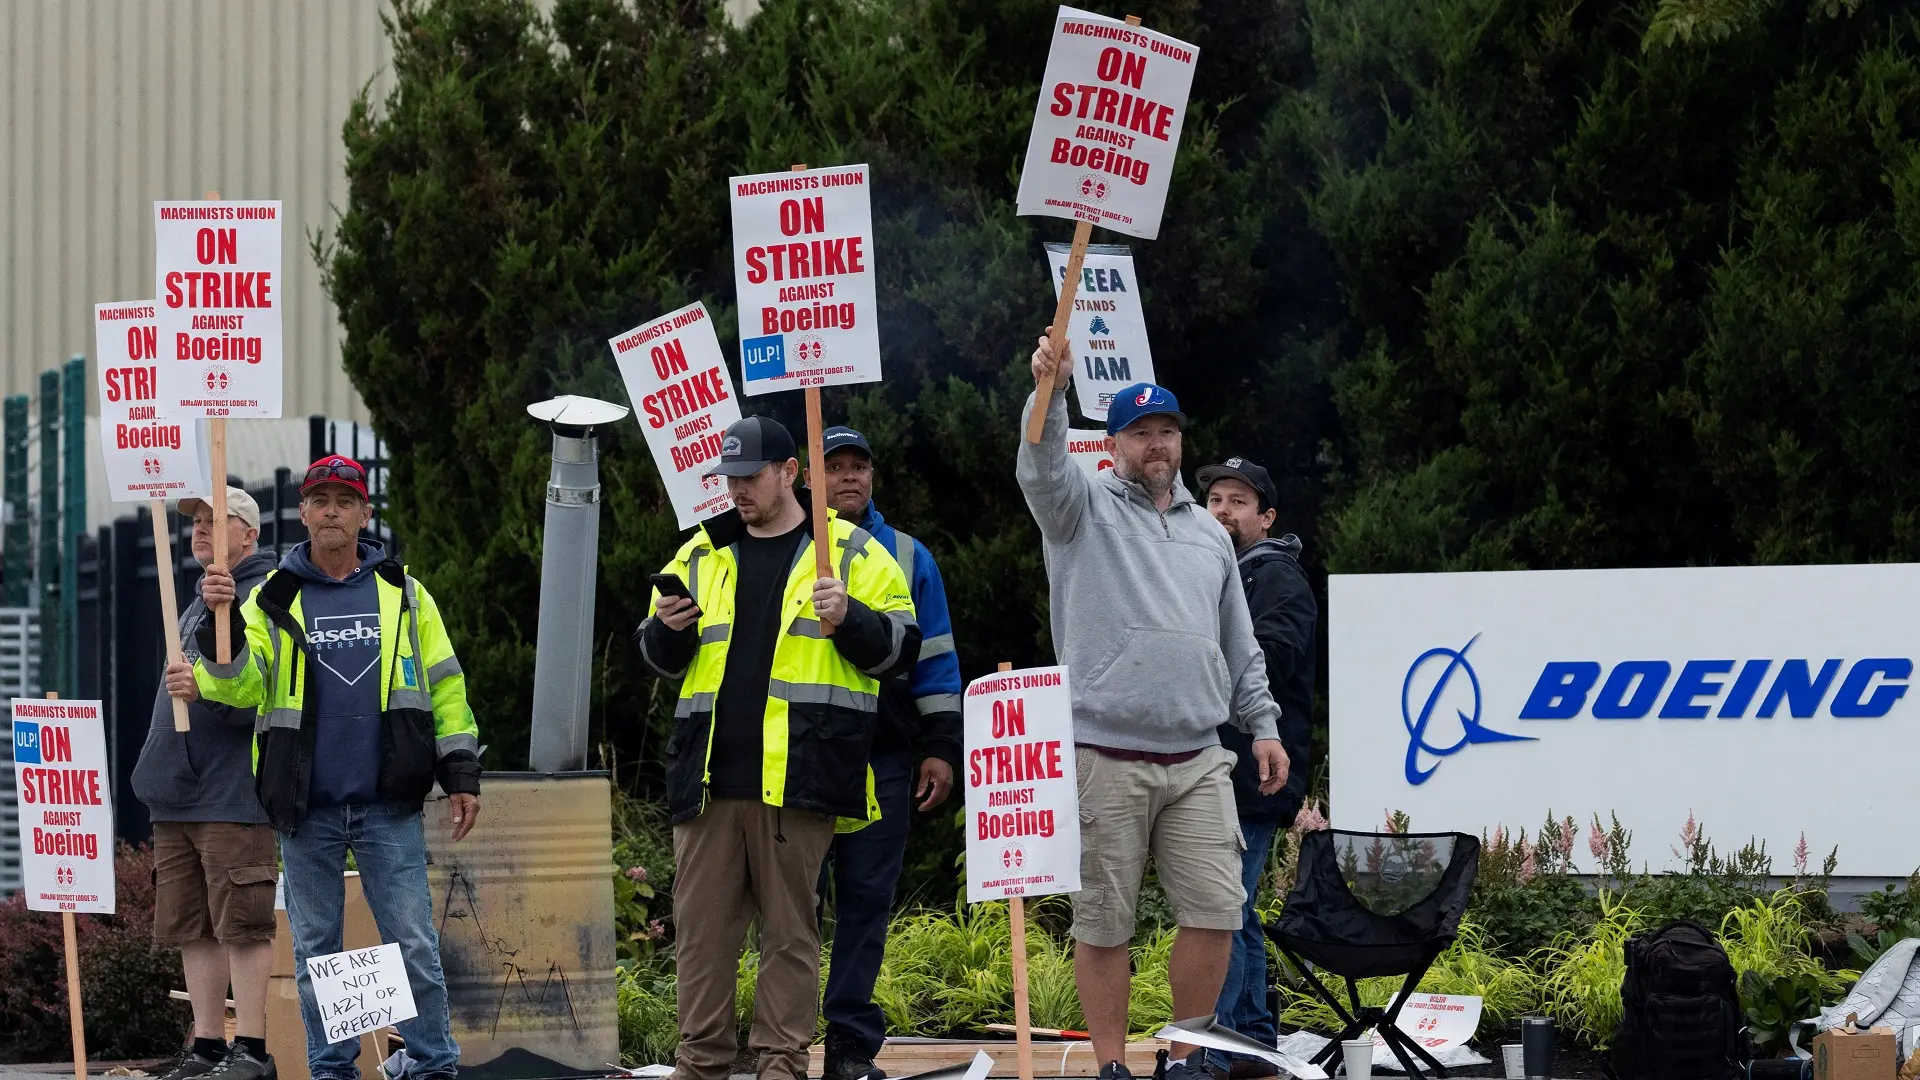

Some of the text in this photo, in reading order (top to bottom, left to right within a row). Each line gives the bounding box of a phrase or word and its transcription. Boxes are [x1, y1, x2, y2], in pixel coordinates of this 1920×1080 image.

[1063, 22, 1192, 64] MACHINISTS UNION
[1097, 47, 1147, 90] ON
[1050, 82, 1174, 142] STRIKE
[1075, 125, 1135, 150] AGAINST
[1050, 137, 1150, 186] Boeing
[737, 172, 863, 197] MACHINISTS UNION
[160, 207, 276, 220] MACHINISTS UNION
[779, 196, 825, 237] ON
[1045, 199, 1133, 224] IAM&AW DISTRICT LODGE 751
[1074, 211, 1100, 223] AFL-CIO
[196, 228, 237, 265] ON
[745, 237, 865, 284] STRIKE
[165, 271, 272, 309] STRIKE
[779, 283, 835, 302] AGAINST
[1060, 266, 1127, 293] EEA
[100, 306, 155, 321] MACHINISTS
[762, 302, 855, 335] Boeing
[1074, 299, 1116, 312] STANDS
[192, 315, 243, 330] AGAINST
[616, 307, 705, 354] MACHINISTS UNION
[127, 326, 157, 361] ON
[176, 332, 262, 364] Boeing
[747, 345, 780, 365] ULP!
[1089, 339, 1115, 350] WITH
[650, 338, 689, 381] ON
[796, 369, 823, 377] DISTRICT
[825, 366, 844, 375] LODGE
[844, 365, 854, 373] 751
[1084, 355, 1132, 381] IAM
[800, 377, 824, 386] AFL-CIO
[206, 408, 230, 416] AFL-CIO
[642, 366, 729, 430] STRIKE
[116, 422, 182, 450] Boeing
[674, 414, 714, 442] AGAINST
[670, 428, 727, 473] Boein
[1067, 440, 1107, 453] ACHIN
[968, 672, 1061, 697] MACHINISTS UNION
[1518, 658, 1913, 719] BOEING
[15, 704, 97, 719] MACHINISTS UNION
[992, 698, 1026, 739] ON
[17, 731, 38, 748] ULP!
[40, 725, 72, 762] ON
[970, 740, 1063, 788] STRIKE
[22, 767, 102, 805] STRIKE
[989, 787, 1034, 808] AGAINST
[43, 810, 81, 826] AGAINST
[978, 807, 1055, 841] Boeing
[33, 827, 98, 860] Boeing
[1001, 877, 1024, 886] DISTRICT
[1025, 876, 1042, 884] LODGE
[1044, 875, 1054, 883] 751
[309, 949, 381, 979] WE ARE
[342, 971, 380, 990] NOT
[321, 987, 399, 1021] LAZY OR
